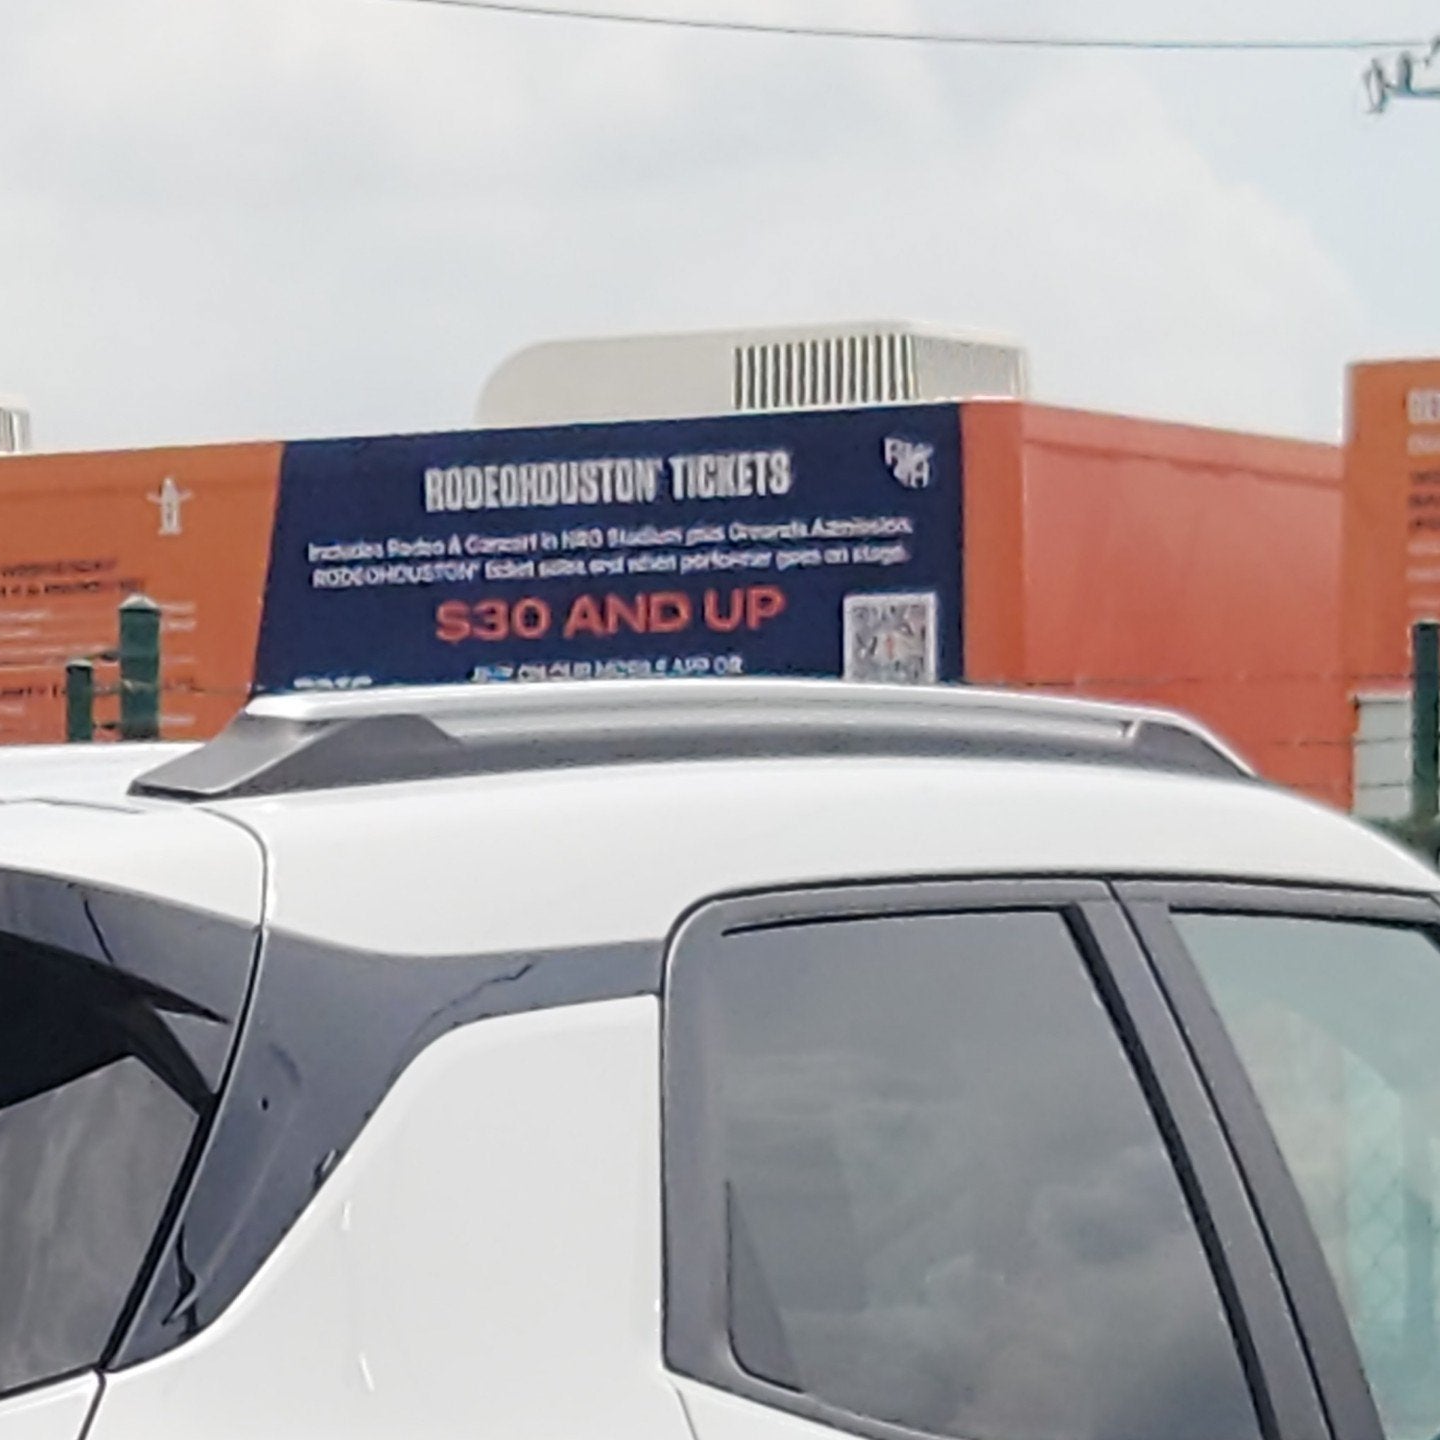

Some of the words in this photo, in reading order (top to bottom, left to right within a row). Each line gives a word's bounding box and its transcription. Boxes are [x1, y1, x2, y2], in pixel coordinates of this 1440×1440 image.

[668, 450, 792, 500] TICKETS
[436, 599, 552, 645] $30
[563, 591, 691, 640] AND
[704, 587, 787, 633] UP
